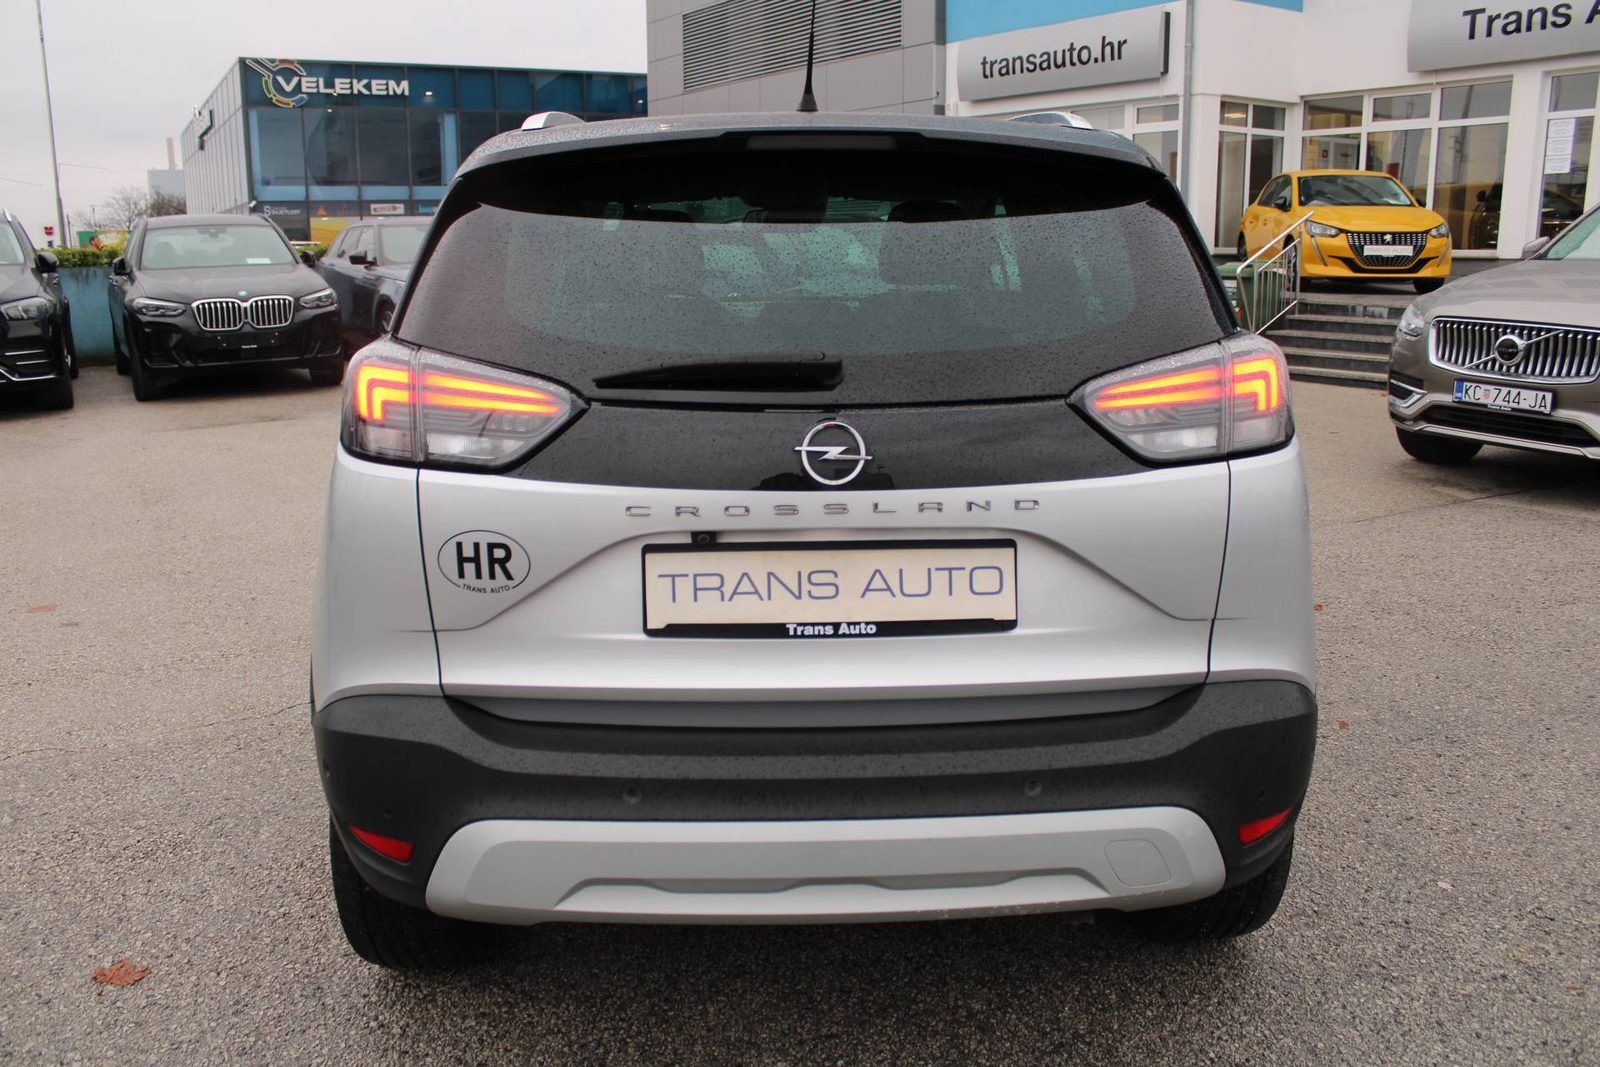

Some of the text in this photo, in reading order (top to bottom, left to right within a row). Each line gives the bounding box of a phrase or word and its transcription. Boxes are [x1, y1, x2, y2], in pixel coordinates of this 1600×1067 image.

[1462, 3, 1573, 40] Trans
[981, 35, 1127, 79] transauto.hr
[276, 76, 410, 96] VELEKEM
[1464, 384, 1548, 410] KC 744-JA
[624, 499, 1041, 518] CROSSLAND
[456, 541, 515, 581] HR
[463, 583, 510, 594] TRANS AUTO
[657, 565, 1004, 603] TRANS AUTO
[786, 622, 877, 636] Trans Auto
